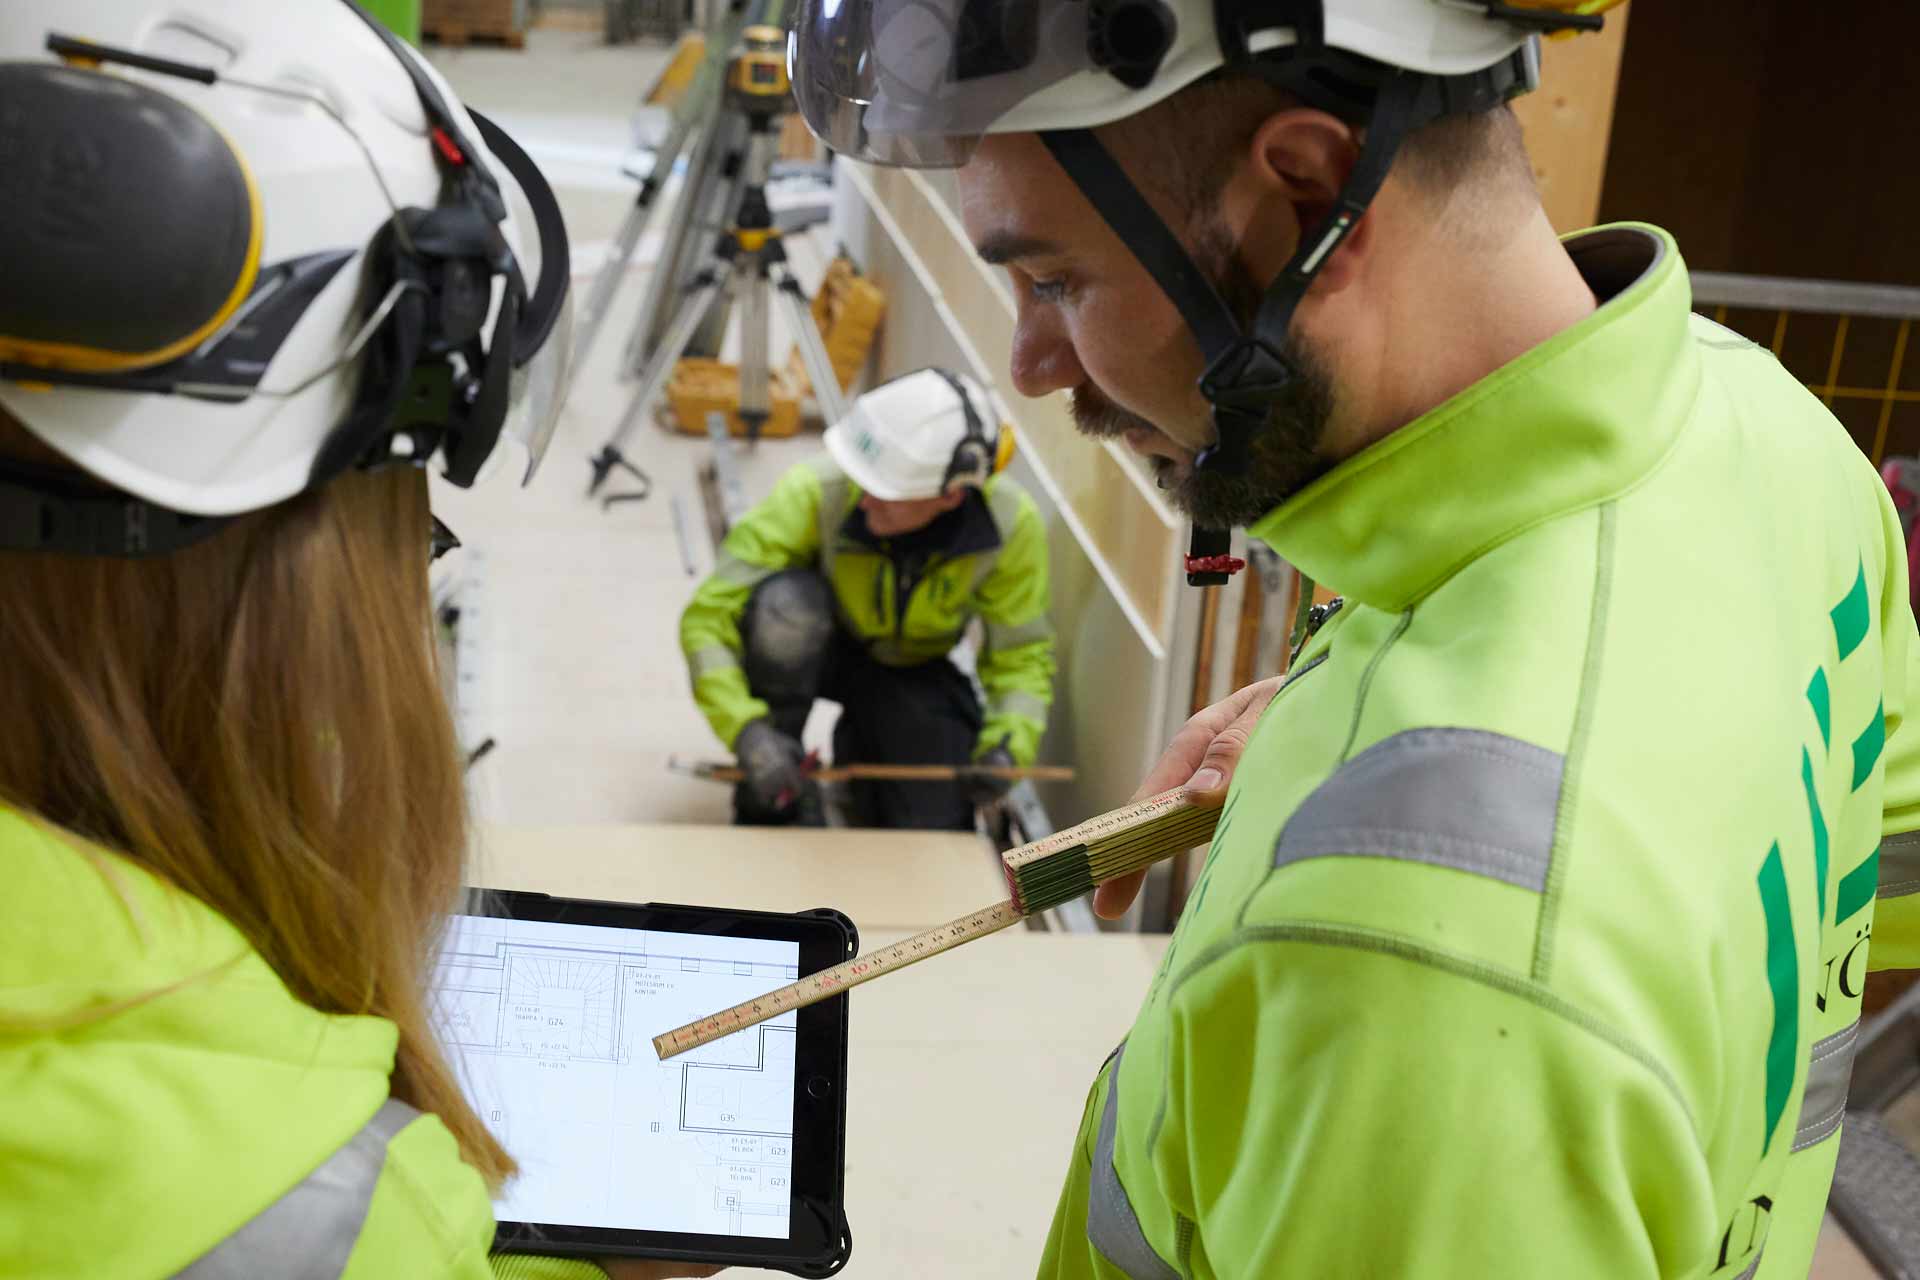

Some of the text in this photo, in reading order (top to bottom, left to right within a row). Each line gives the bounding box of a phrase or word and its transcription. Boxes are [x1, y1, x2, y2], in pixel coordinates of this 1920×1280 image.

[951, 926, 965, 936] 15
[548, 1018, 564, 1026] G24
[720, 1113, 735, 1122] G35
[771, 1147, 786, 1155] G23
[770, 1178, 786, 1186] G23
